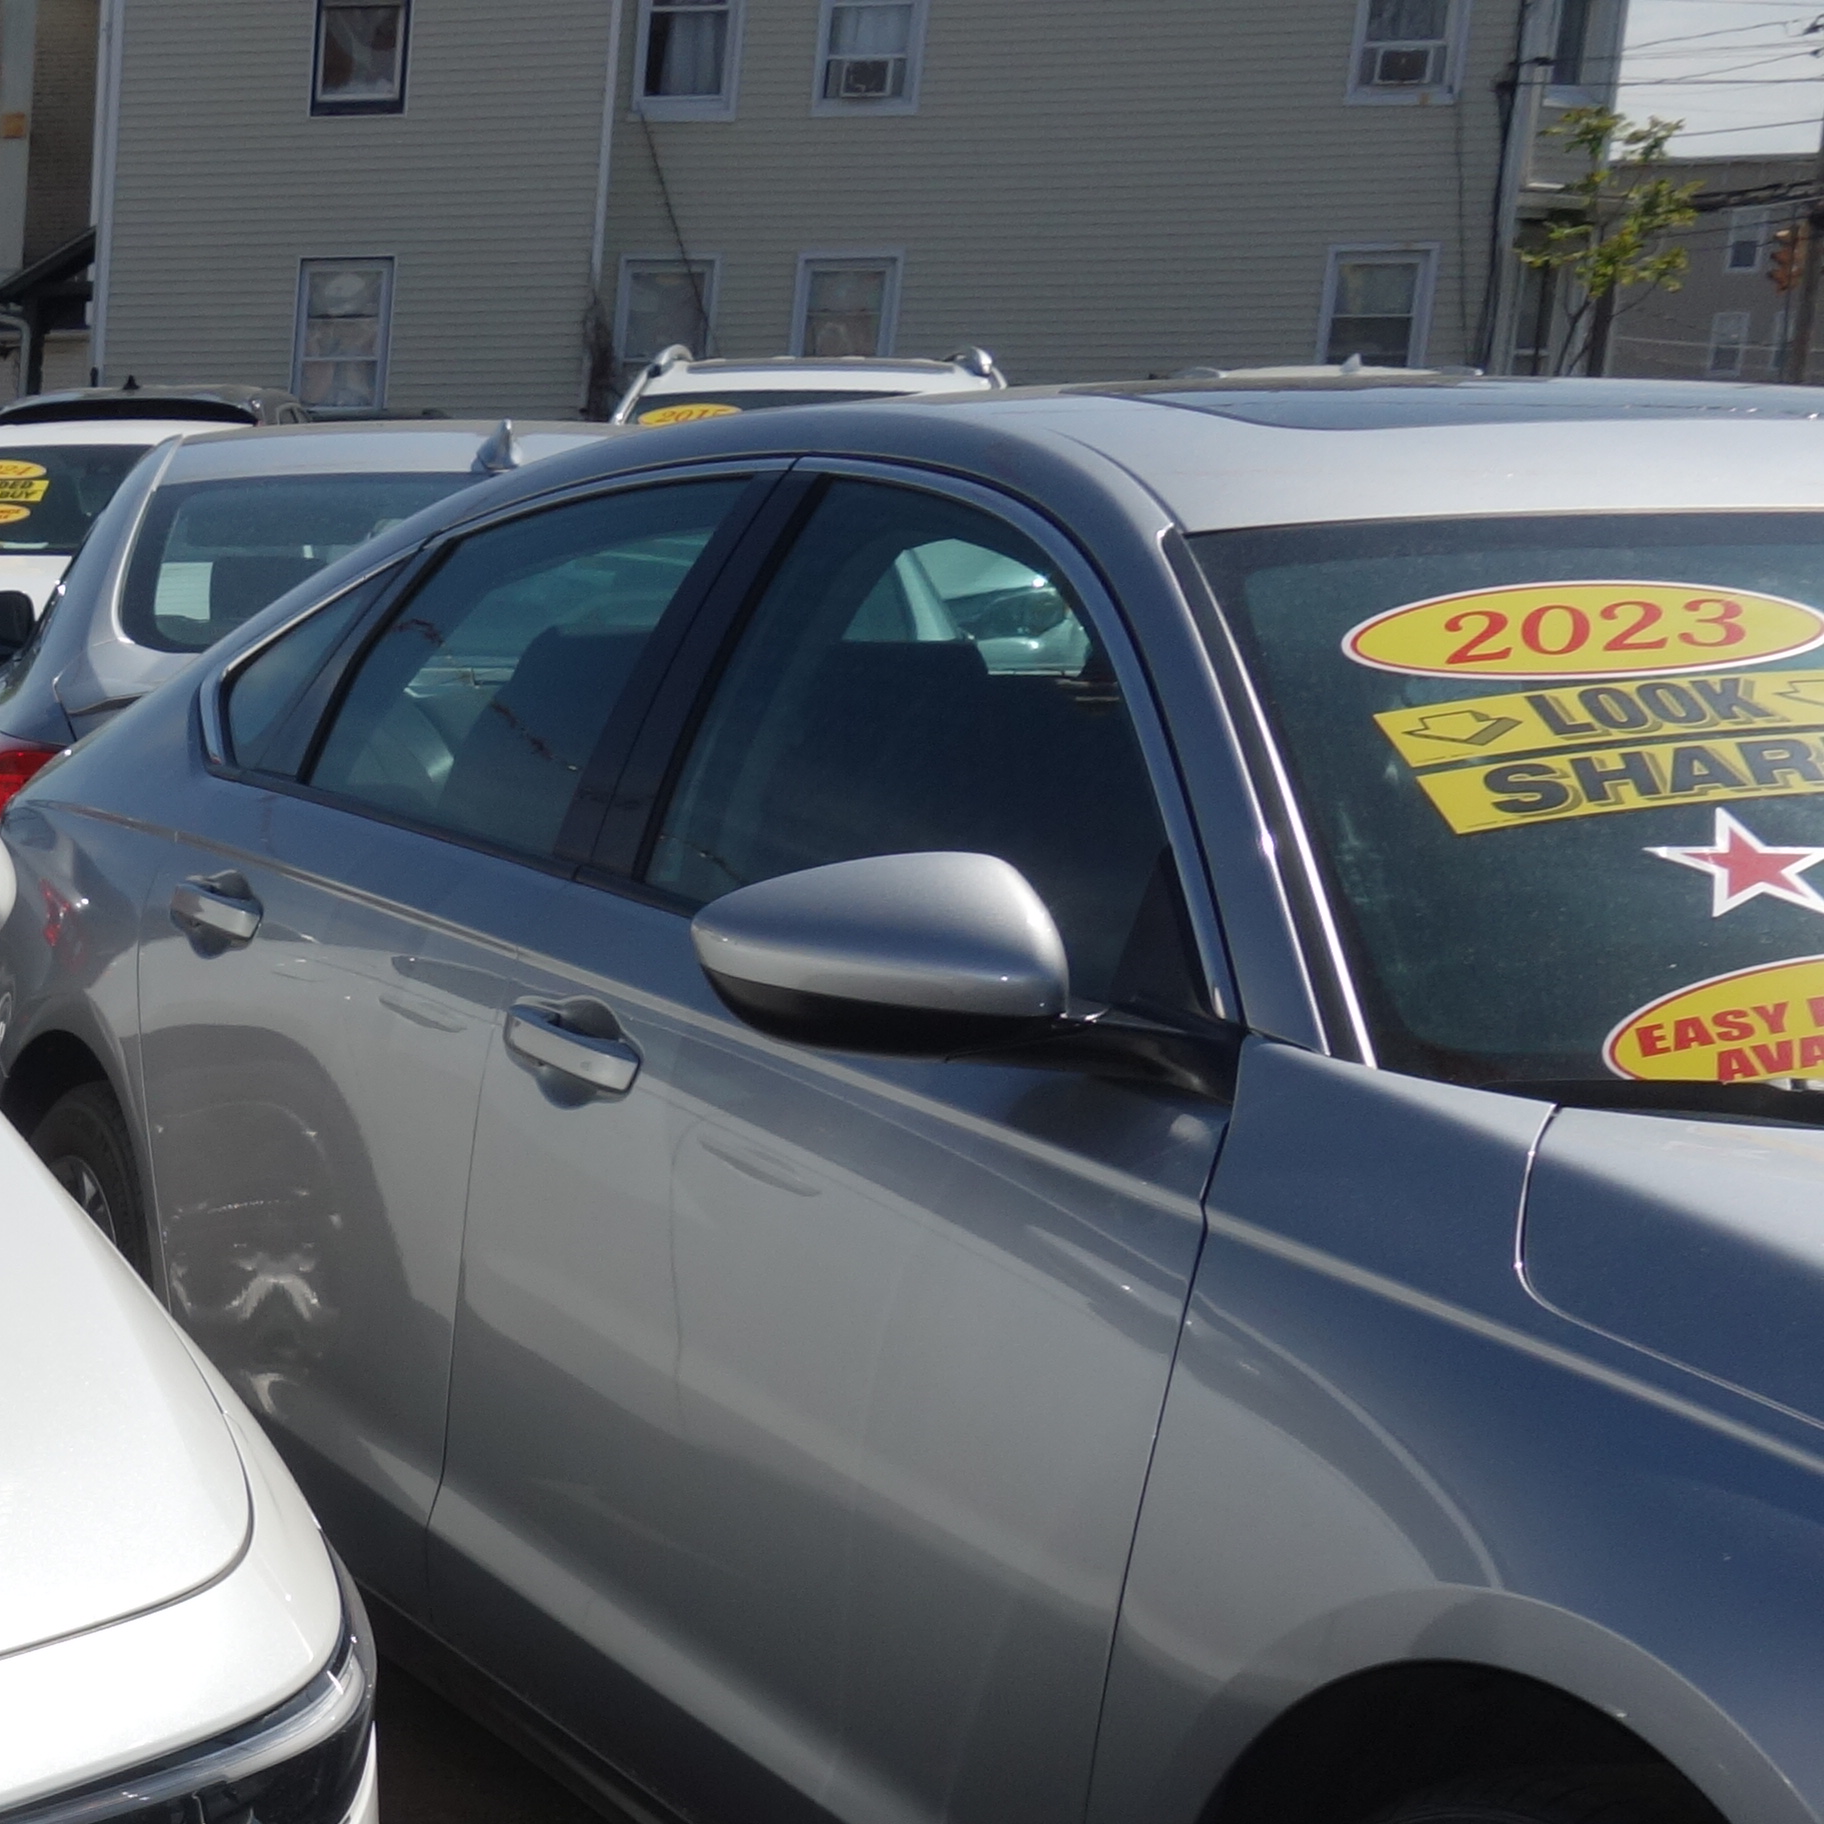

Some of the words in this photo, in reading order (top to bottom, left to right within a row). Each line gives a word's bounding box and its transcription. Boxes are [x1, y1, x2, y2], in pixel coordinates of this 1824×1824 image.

[1445, 598, 1748, 665] 2023
[1526, 678, 1772, 738] LOOK
[1635, 1001, 1789, 1057] EASY
